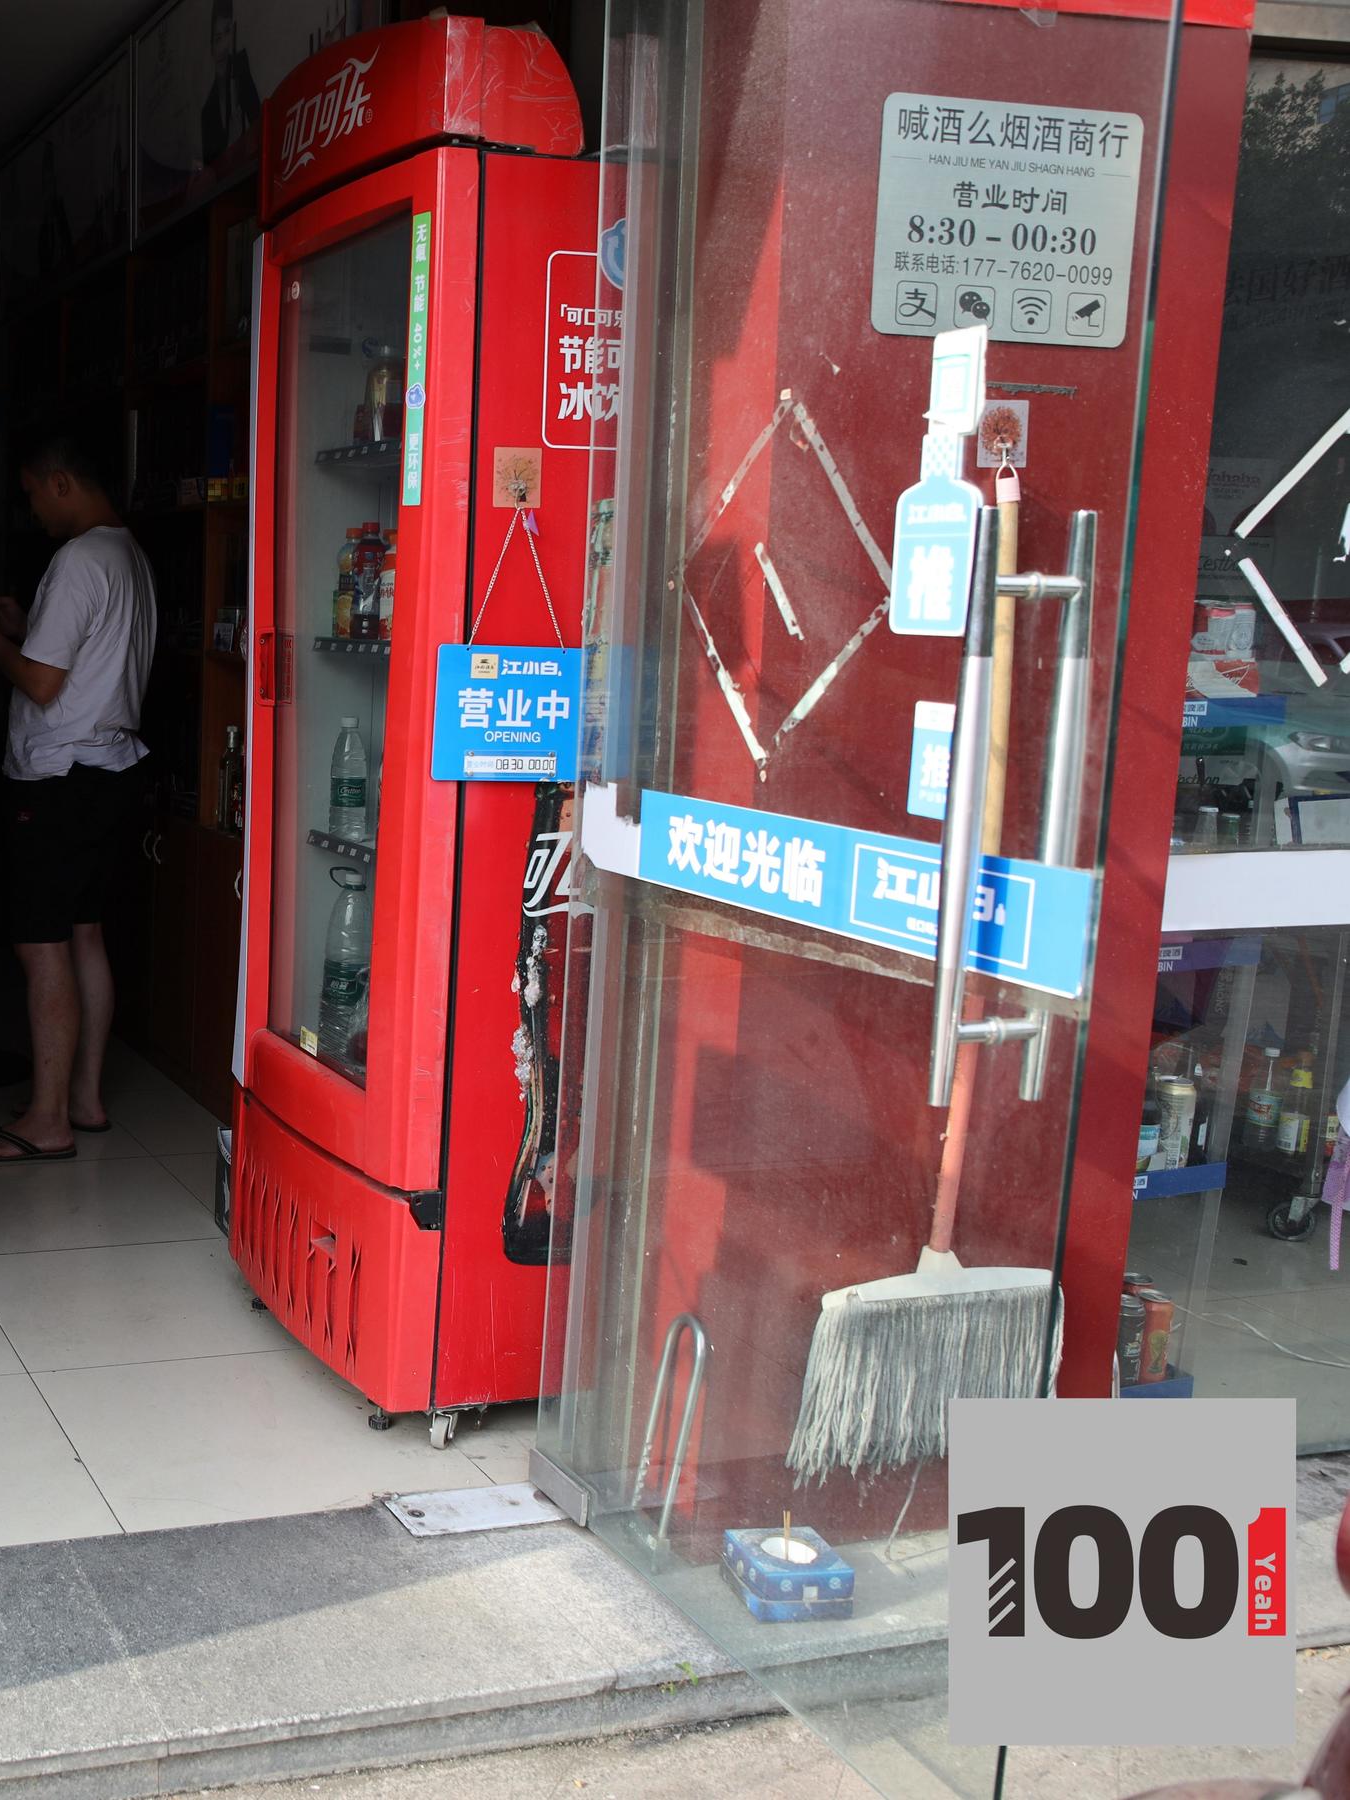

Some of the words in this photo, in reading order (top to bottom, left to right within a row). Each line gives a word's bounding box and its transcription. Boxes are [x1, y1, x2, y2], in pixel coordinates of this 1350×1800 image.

[280, 46, 380, 180] 可口可乐
[898, 104, 1129, 159] 喊酒么烟酒商行
[929, 154, 950, 166] HAN
[953, 156, 968, 167] JIU
[970, 157, 986, 169] ME
[988, 159, 1009, 171] YAN
[1011, 160, 1026, 172] JIU
[1028, 162, 1064, 175] SHAGN
[1066, 164, 1095, 178] HANG
[953, 181, 1067, 215] 营业时间
[907, 214, 975, 247] 8:30
[1012, 223, 1096, 256] 00:30
[501, 659, 559, 676] 江小白
[458, 688, 570, 730] 营业中
[485, 731, 541, 743] OPENING
[666, 814, 826, 908] 欢迎光临
